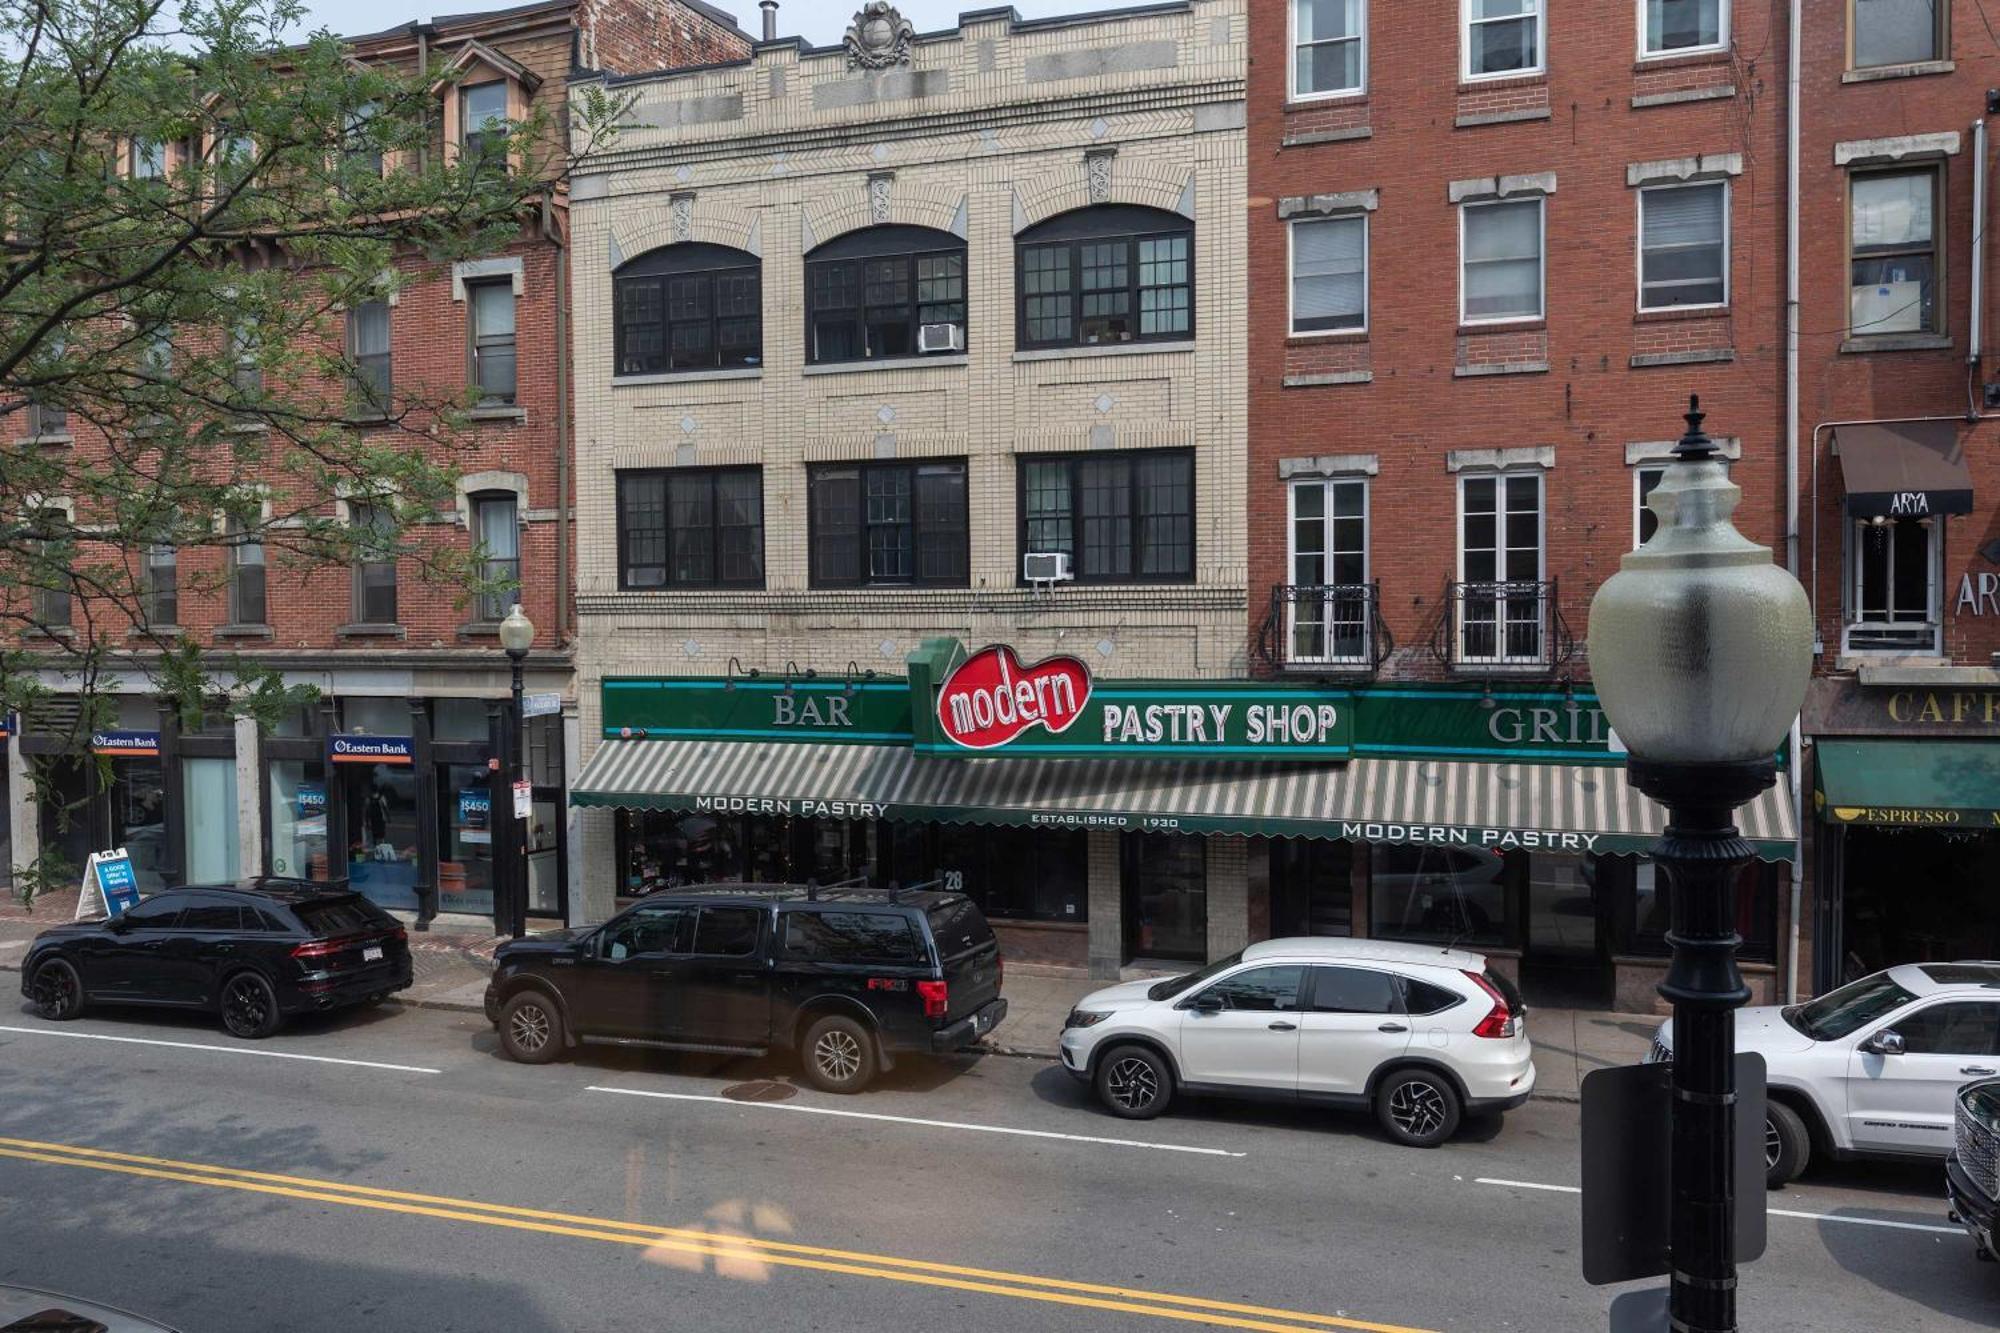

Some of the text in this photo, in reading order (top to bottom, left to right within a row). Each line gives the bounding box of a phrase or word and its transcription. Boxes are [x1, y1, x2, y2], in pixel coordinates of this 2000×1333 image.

[1890, 492, 1929, 514] ARYA
[1955, 572, 2000, 616] AR
[950, 648, 1077, 735] modern
[772, 695, 853, 726] BAR
[1103, 704, 1337, 743] PASTRY SHOP
[1488, 708, 1609, 743] GRIL
[103, 736, 157, 747] Eastern Bank
[345, 743, 408, 754] Eastern Bank
[696, 797, 888, 817] MODERN PASTRY
[1868, 808, 1960, 823] ESPRESSO
[1031, 813, 1178, 828] ESTABLISHED 1930
[1342, 822, 1600, 850] MODERN PASTRY
[945, 871, 963, 890] 28
